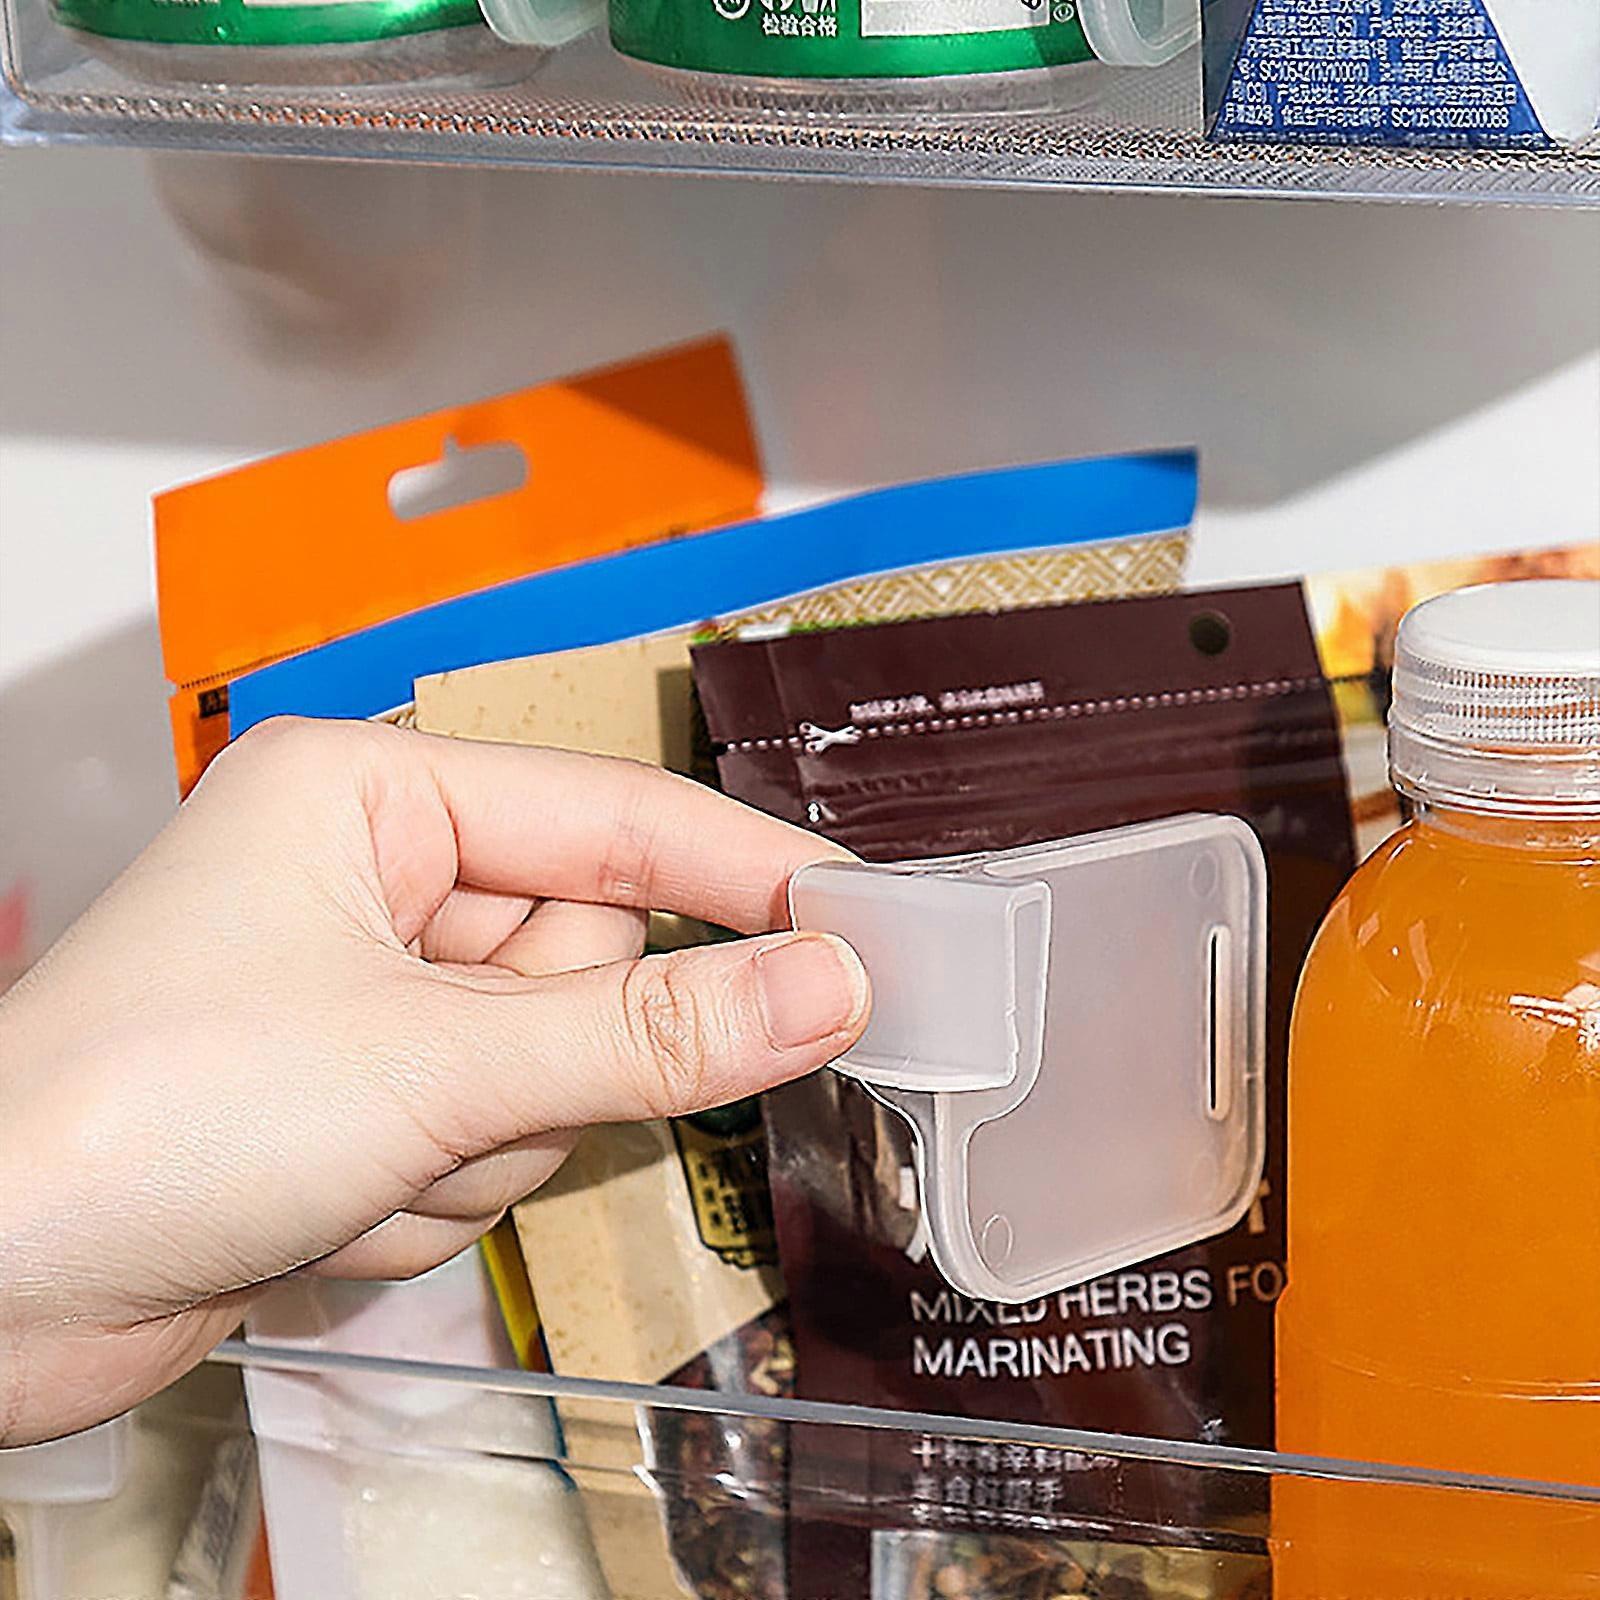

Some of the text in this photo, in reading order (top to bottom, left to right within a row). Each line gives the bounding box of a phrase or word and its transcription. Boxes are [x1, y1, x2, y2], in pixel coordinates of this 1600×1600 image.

[762, 12, 838, 38] 检验合格
[910, 1260, 1288, 1325] MIXED HERBS FO
[913, 1323, 1192, 1378] MARINATING
